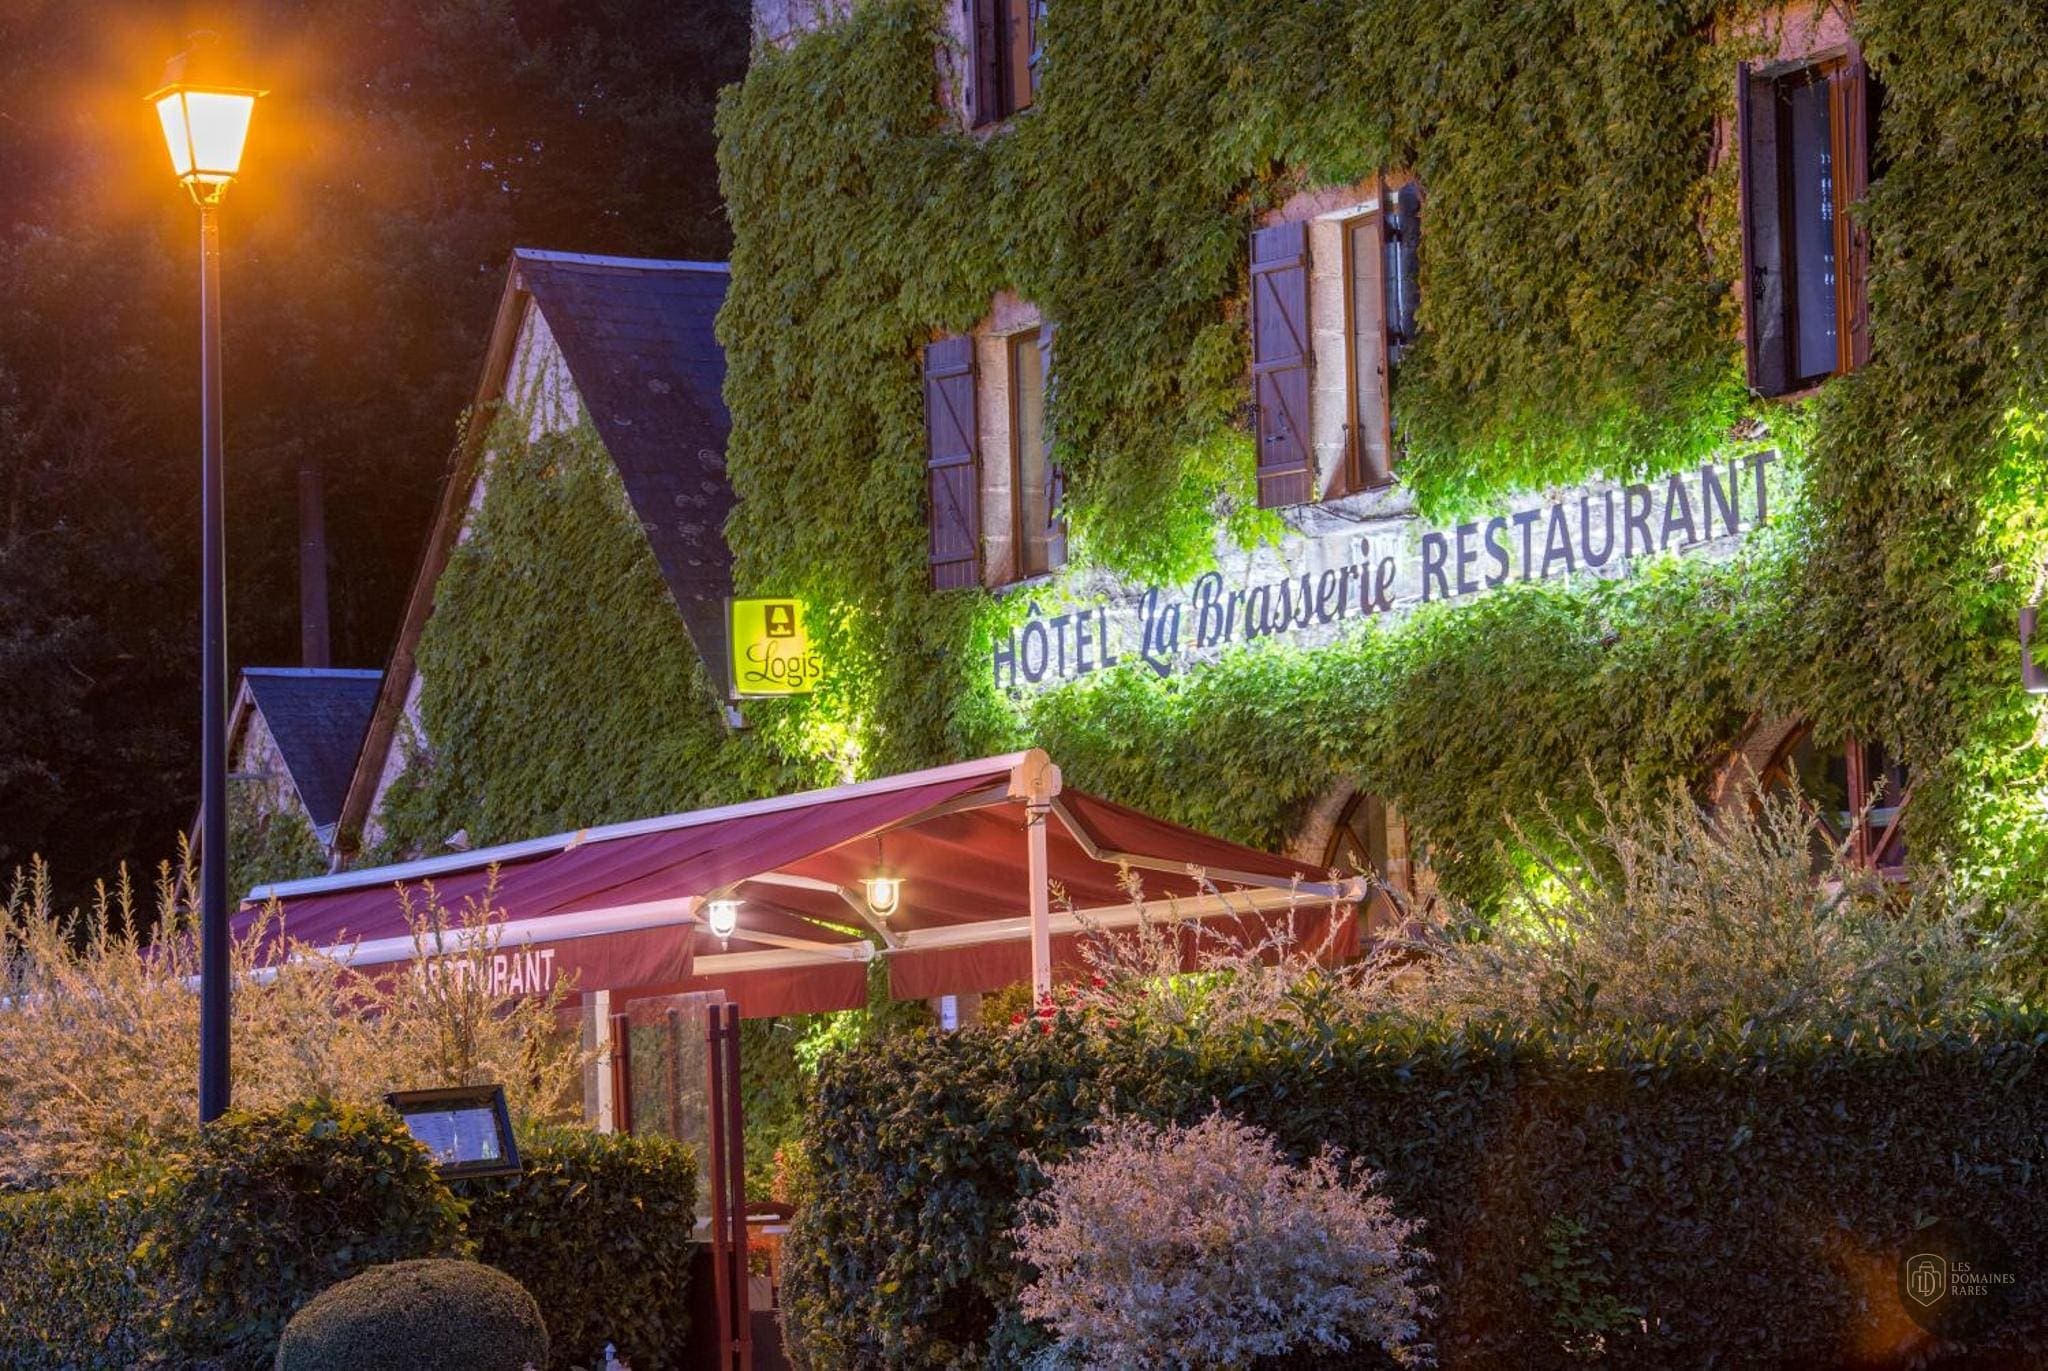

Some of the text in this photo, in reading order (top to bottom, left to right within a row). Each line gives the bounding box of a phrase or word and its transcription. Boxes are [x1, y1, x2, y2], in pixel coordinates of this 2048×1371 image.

[993, 449, 1777, 690] HÔTEL La Brasserie RESTAURANT
[745, 640, 820, 688] Logis
